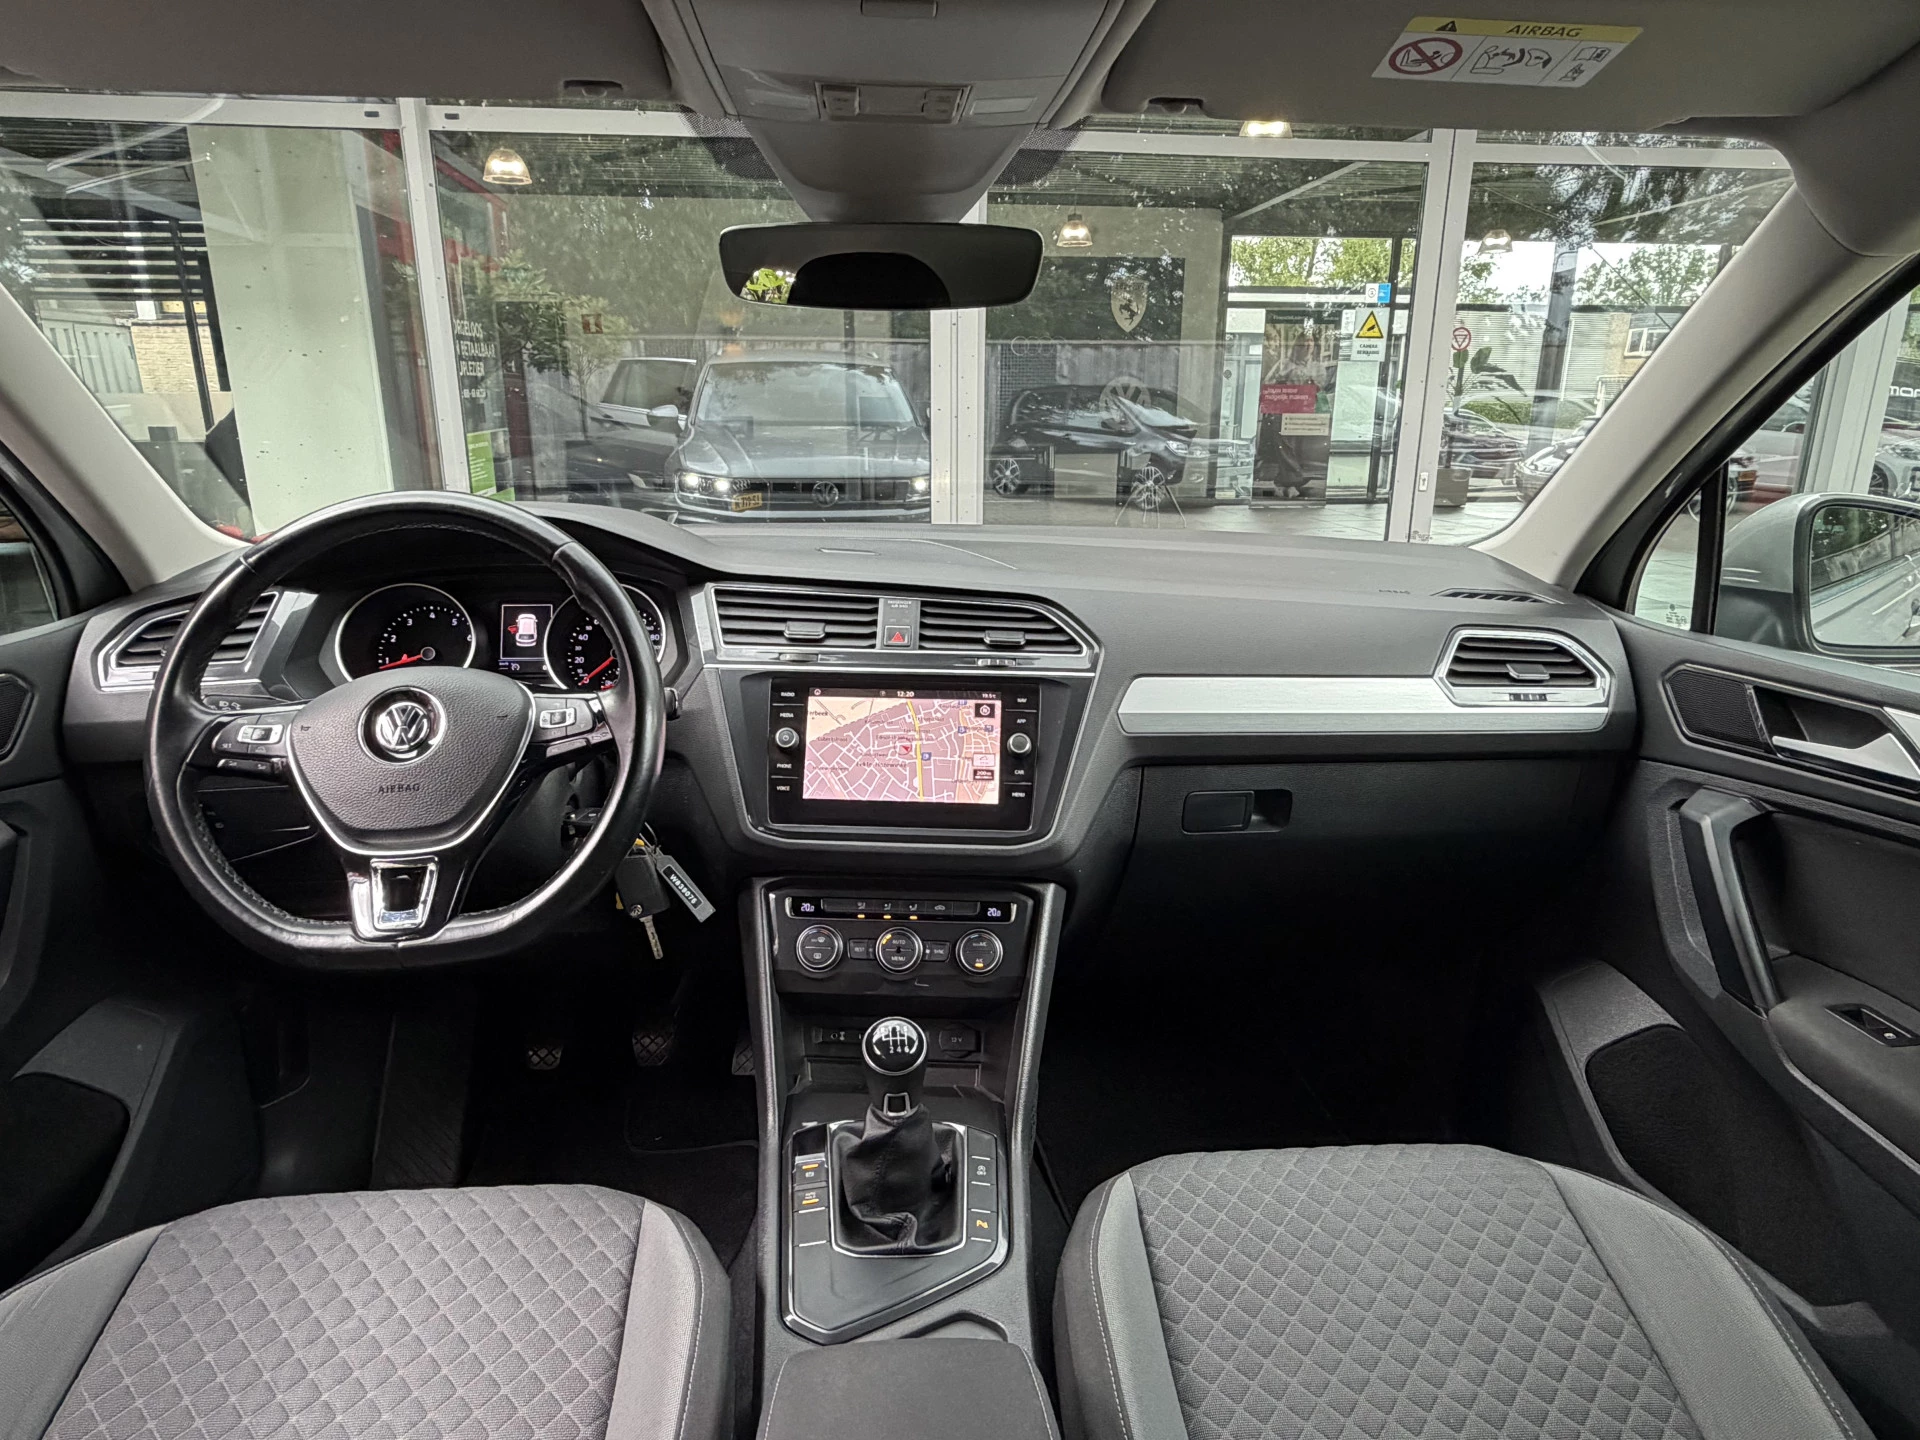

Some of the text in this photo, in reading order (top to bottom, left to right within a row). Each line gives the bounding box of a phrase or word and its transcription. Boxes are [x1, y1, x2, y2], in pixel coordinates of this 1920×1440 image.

[1506, 24, 1583, 38] AIRBAG
[406, 618, 413, 626] 3
[451, 618, 458, 626] 5
[390, 635, 397, 643] 2
[578, 633, 589, 641] 40
[574, 656, 585, 664] 20
[378, 783, 420, 793] AIRBAG
[889, 1046, 894, 1054] 2
[904, 1045, 910, 1053] 6
